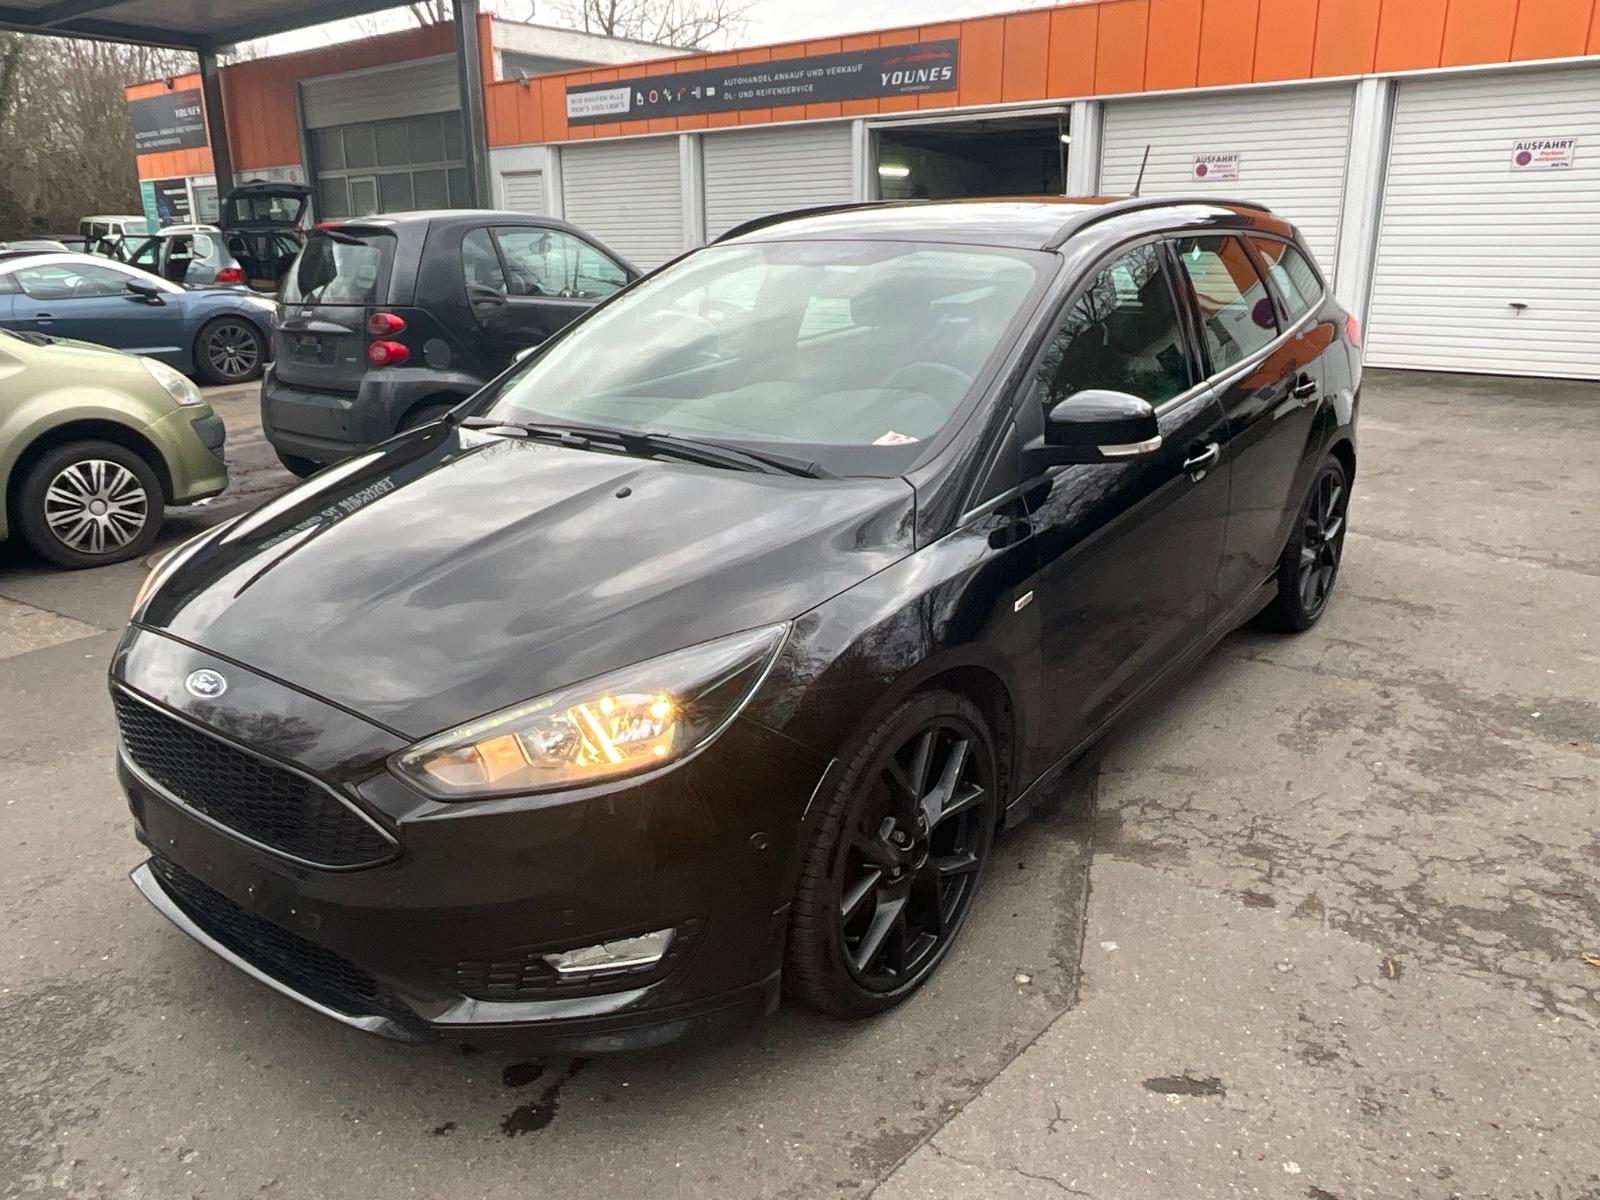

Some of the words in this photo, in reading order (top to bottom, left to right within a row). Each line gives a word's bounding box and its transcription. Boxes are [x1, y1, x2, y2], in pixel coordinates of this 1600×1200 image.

[723, 75, 772, 87] AUTOHANDEL
[774, 70, 805, 81] ANKAUF
[806, 68, 824, 78] UND
[825, 64, 863, 76] VERKAUF
[881, 66, 953, 87] YOUNES
[738, 90, 754, 99] UND
[756, 84, 814, 97] REIFENSERVICE
[1516, 140, 1573, 150] AUSFAHRT
[1195, 154, 1238, 163] AUSFAHRT
